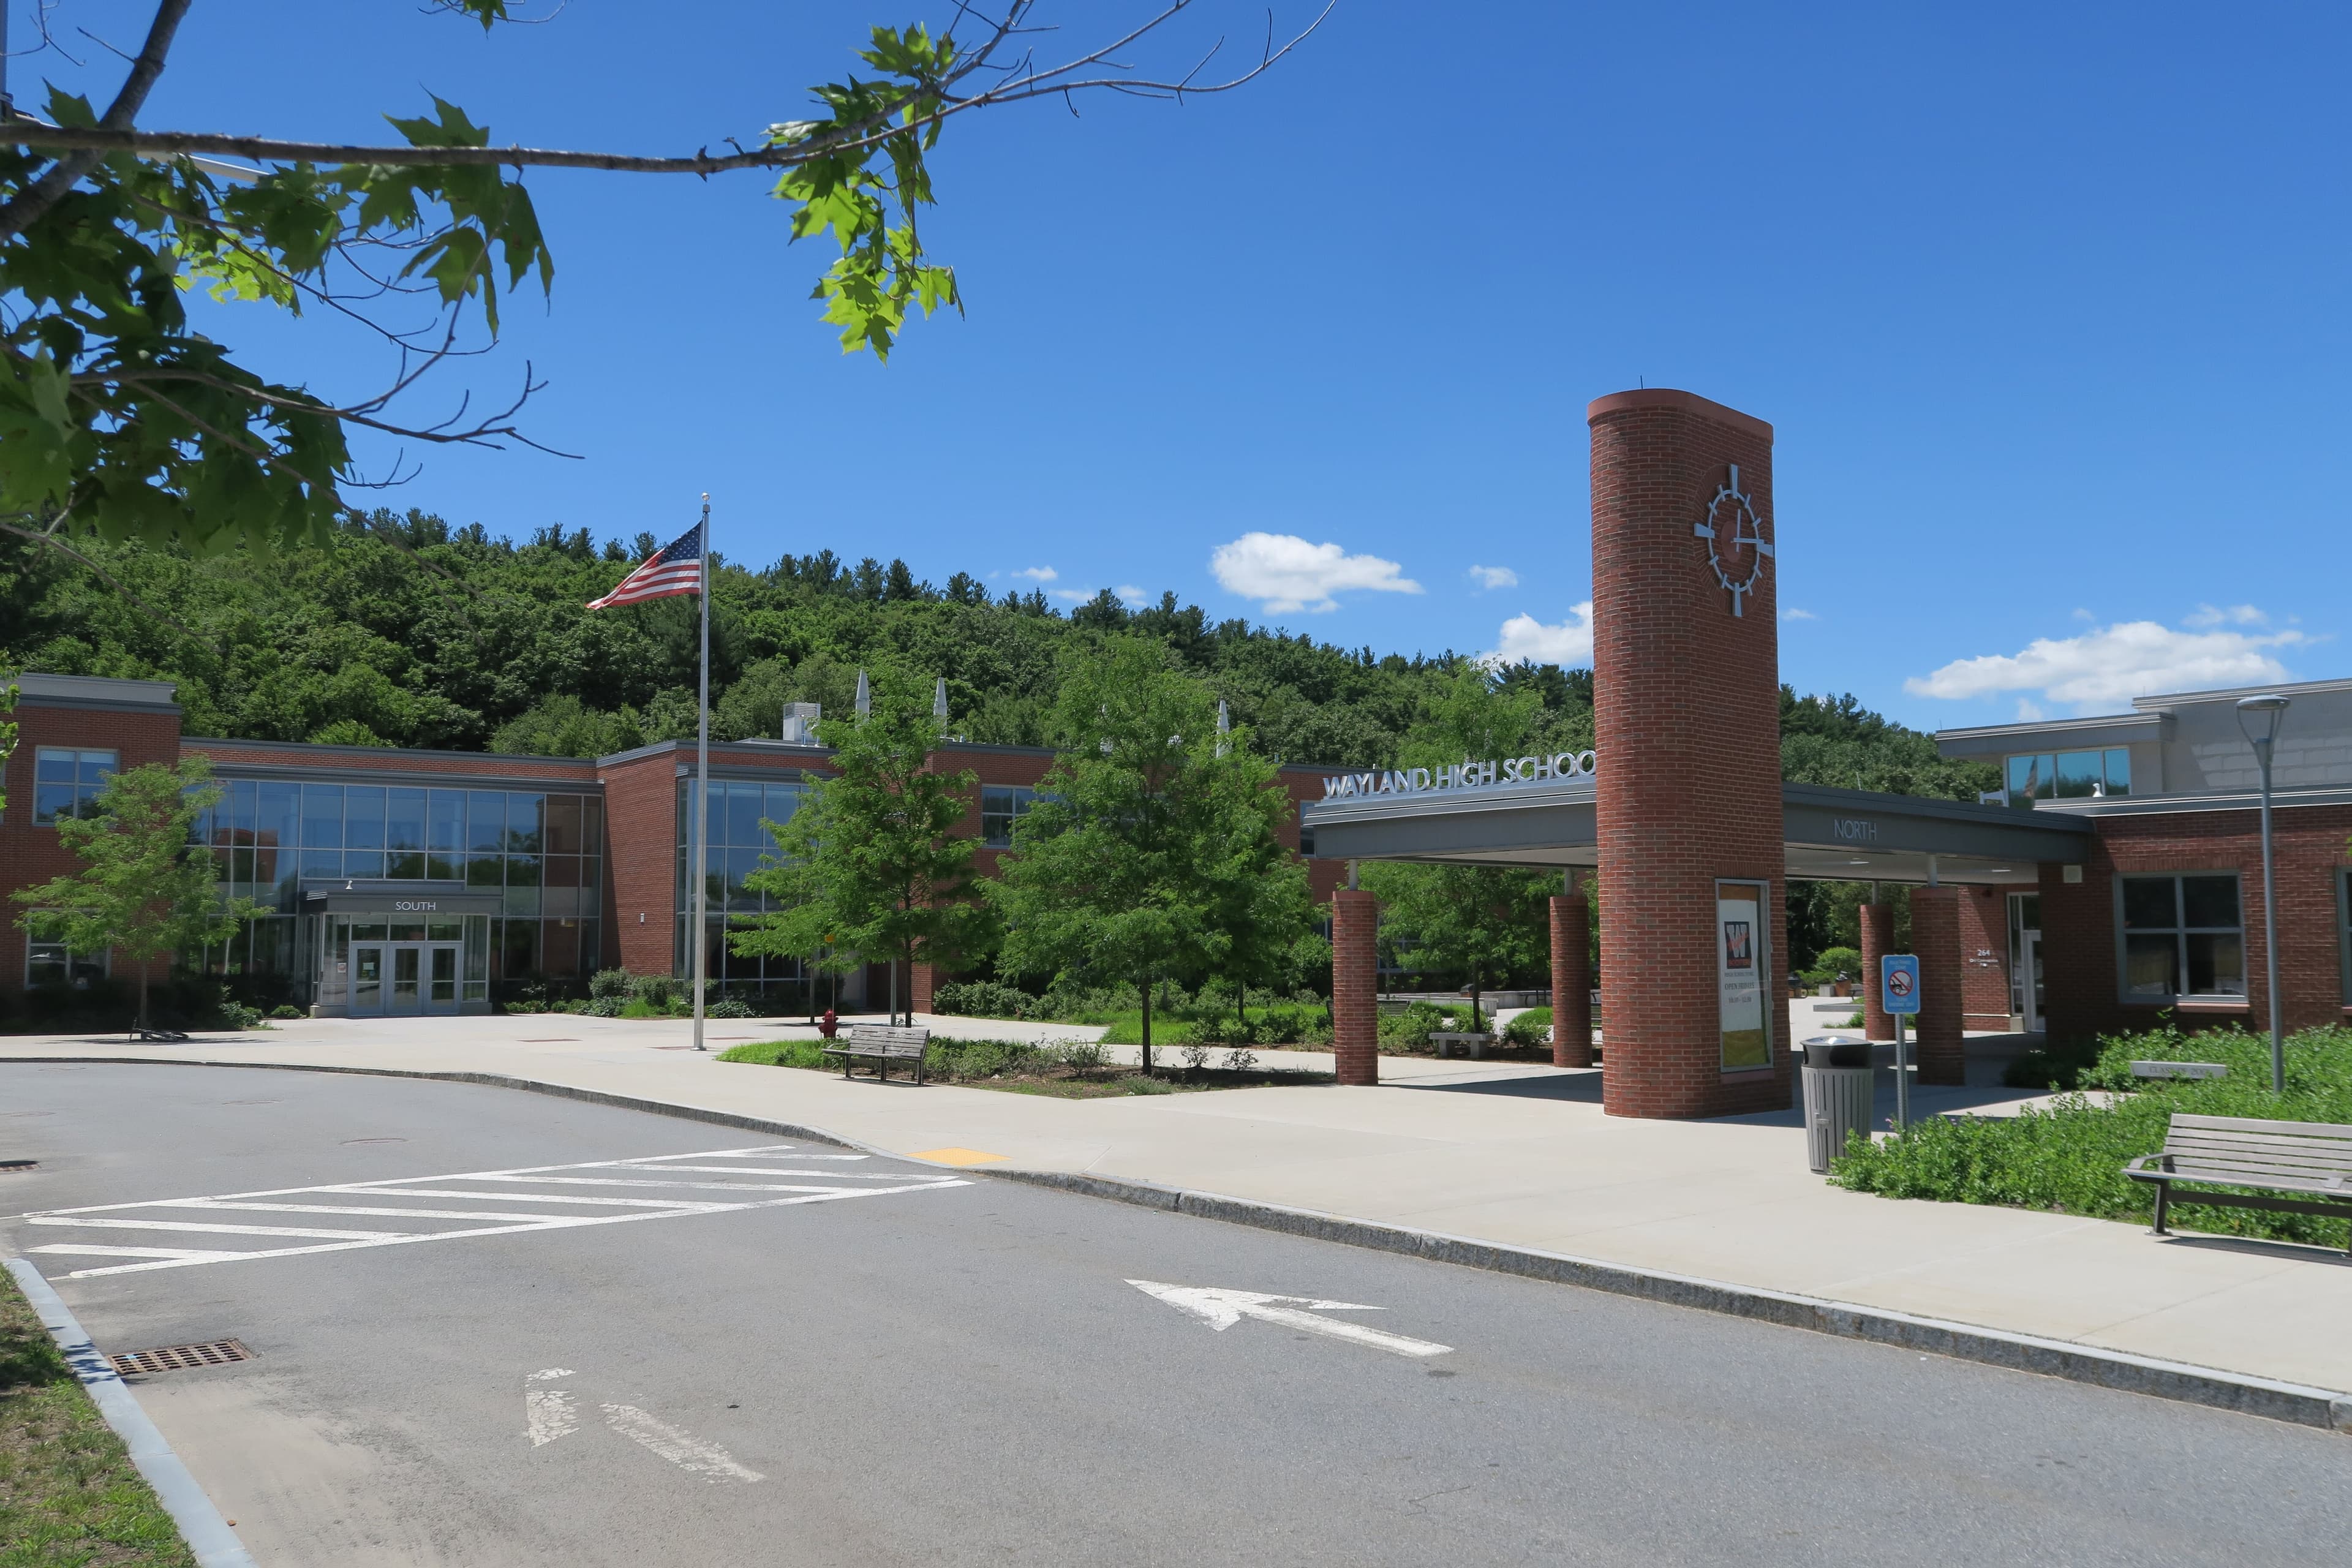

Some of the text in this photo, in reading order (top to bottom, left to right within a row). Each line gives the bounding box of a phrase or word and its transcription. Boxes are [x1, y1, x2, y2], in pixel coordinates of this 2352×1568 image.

[1323, 750, 1596, 799] WAYLAND HIGH SCHOO
[1834, 819, 1877, 841] NORTH
[395, 901, 436, 911] SOUTH
